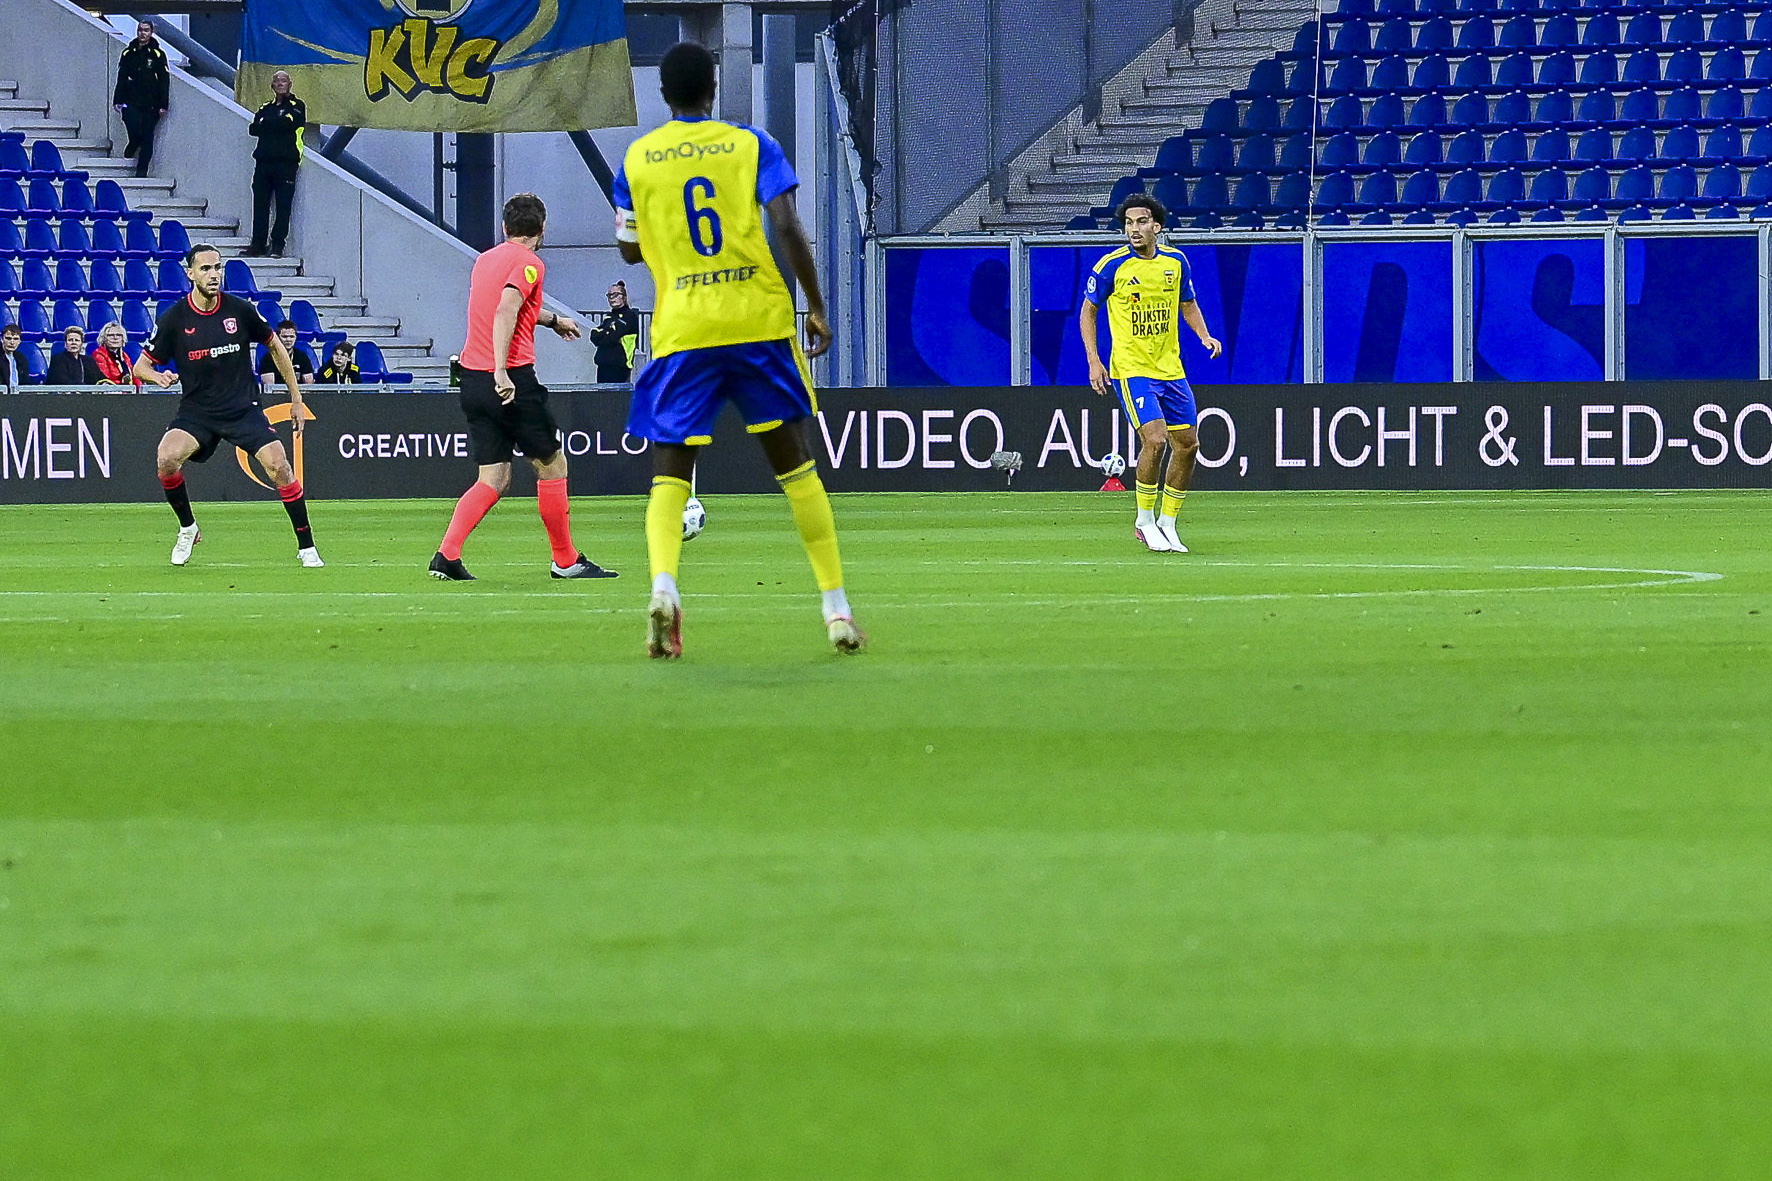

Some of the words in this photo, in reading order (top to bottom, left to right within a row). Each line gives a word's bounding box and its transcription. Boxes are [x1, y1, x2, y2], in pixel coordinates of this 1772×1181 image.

[364, 17, 497, 105] KVC
[683, 176, 723, 257] 6
[676, 265, 760, 290] EFFEKTIEF
[1131, 309, 1171, 324] DIJKSTRA
[1135, 396, 1145, 409] 7
[338, 432, 469, 458] CREATIVE
[1275, 405, 1458, 468] LICHT
[1478, 404, 1520, 467] &
